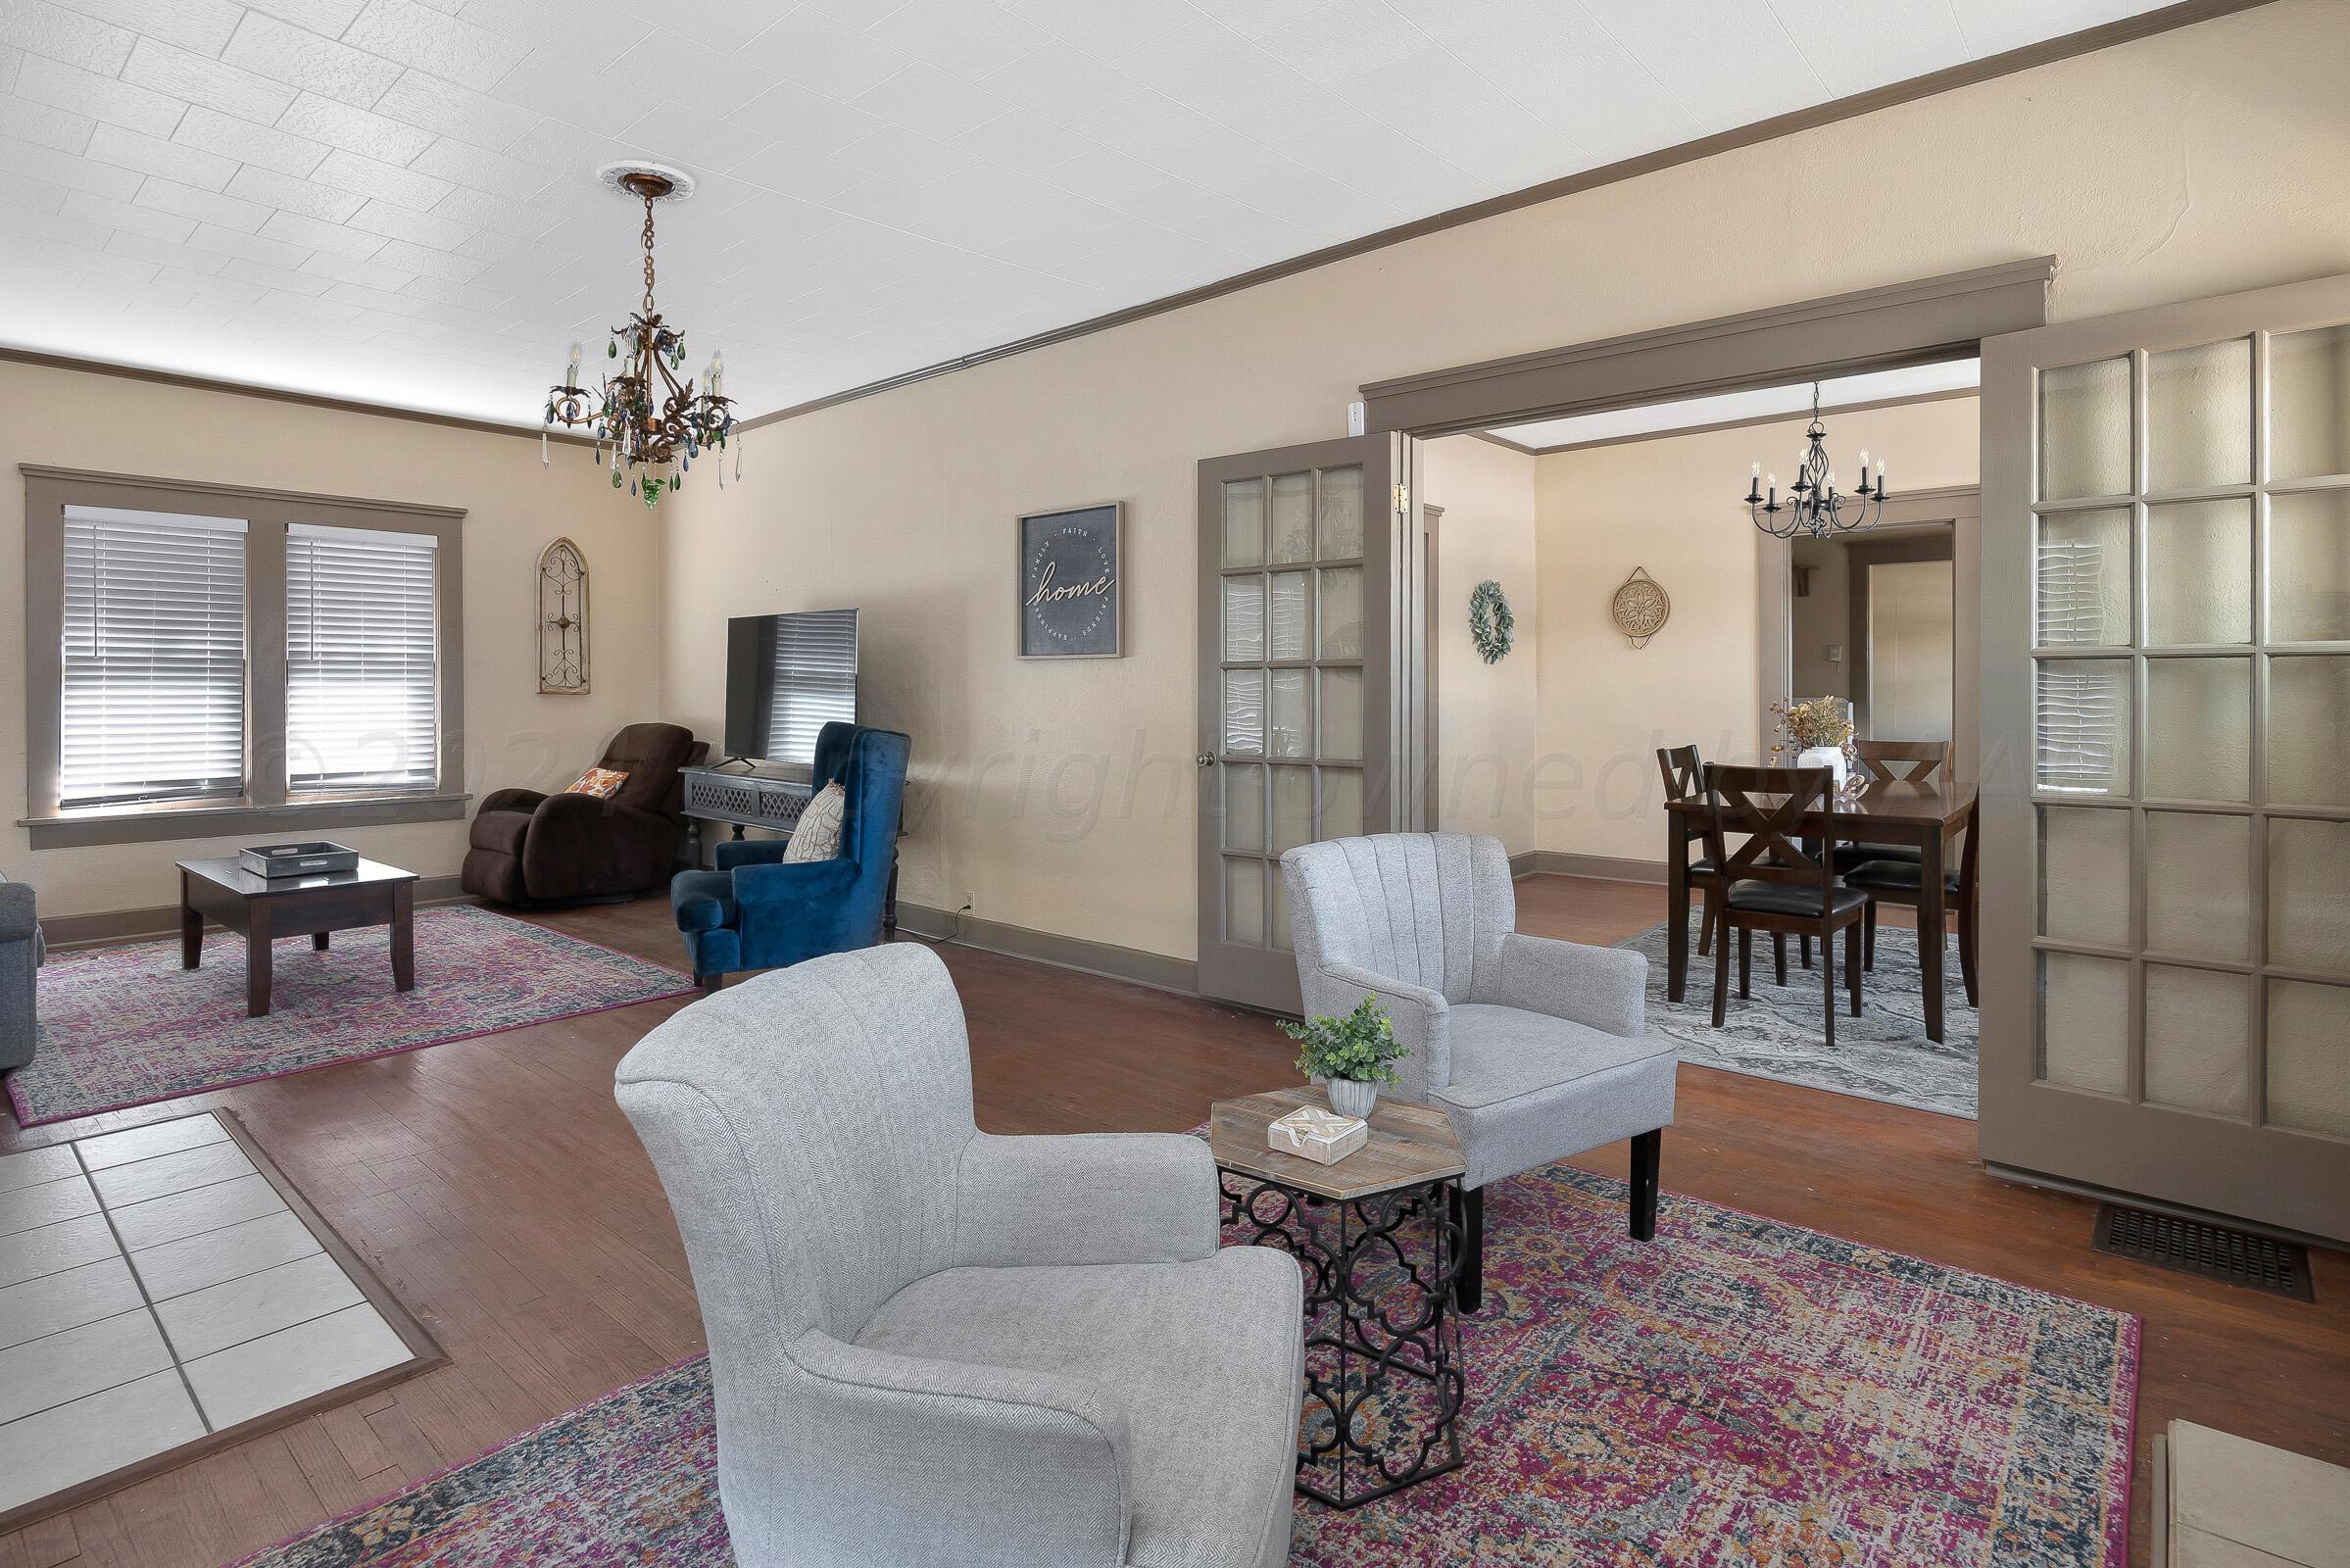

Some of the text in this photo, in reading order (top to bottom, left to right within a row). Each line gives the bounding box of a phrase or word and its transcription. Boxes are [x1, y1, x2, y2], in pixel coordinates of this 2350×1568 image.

[1061, 527, 1089, 537] FAITH
[1031, 540, 1051, 579] FAMILY
[1098, 547, 1111, 574] LOVE
[1025, 561, 1115, 607] home
